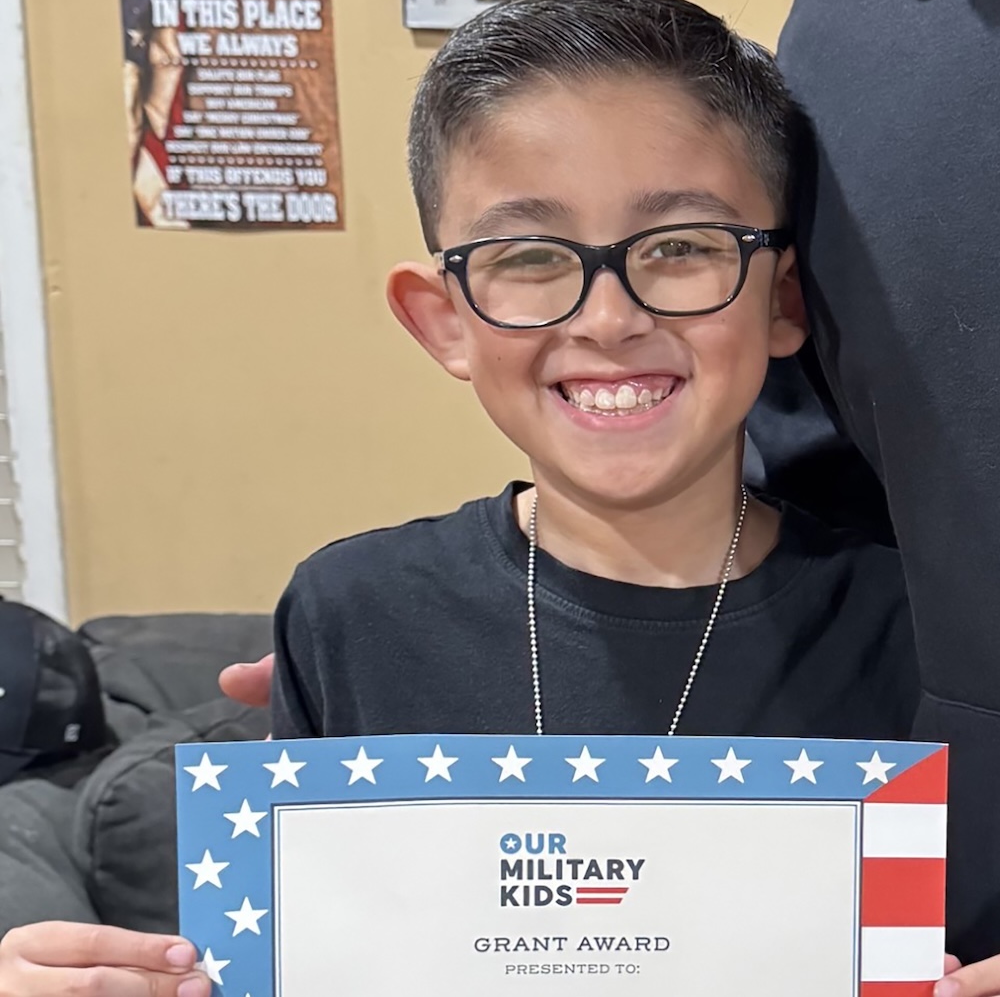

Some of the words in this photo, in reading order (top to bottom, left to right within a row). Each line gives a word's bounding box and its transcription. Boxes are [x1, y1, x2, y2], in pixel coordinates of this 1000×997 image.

[177, 32, 212, 55] WE
[216, 33, 299, 57] ALWAYS
[166, 165, 182, 184] IF
[184, 166, 222, 185] THIS
[224, 167, 294, 186] OFFENDS
[295, 168, 327, 186] YOU
[161, 190, 241, 222] THERE'S
[242, 192, 284, 222] THE
[285, 192, 338, 223] DOOR
[500, 833, 567, 854] OUR
[500, 859, 645, 880] MILITARY
[500, 885, 573, 907] KIDS
[474, 937, 568, 952] GRANT
[576, 936, 671, 951] AWARD
[505, 963, 610, 975] PRESENTED
[614, 963, 641, 975] TO:
